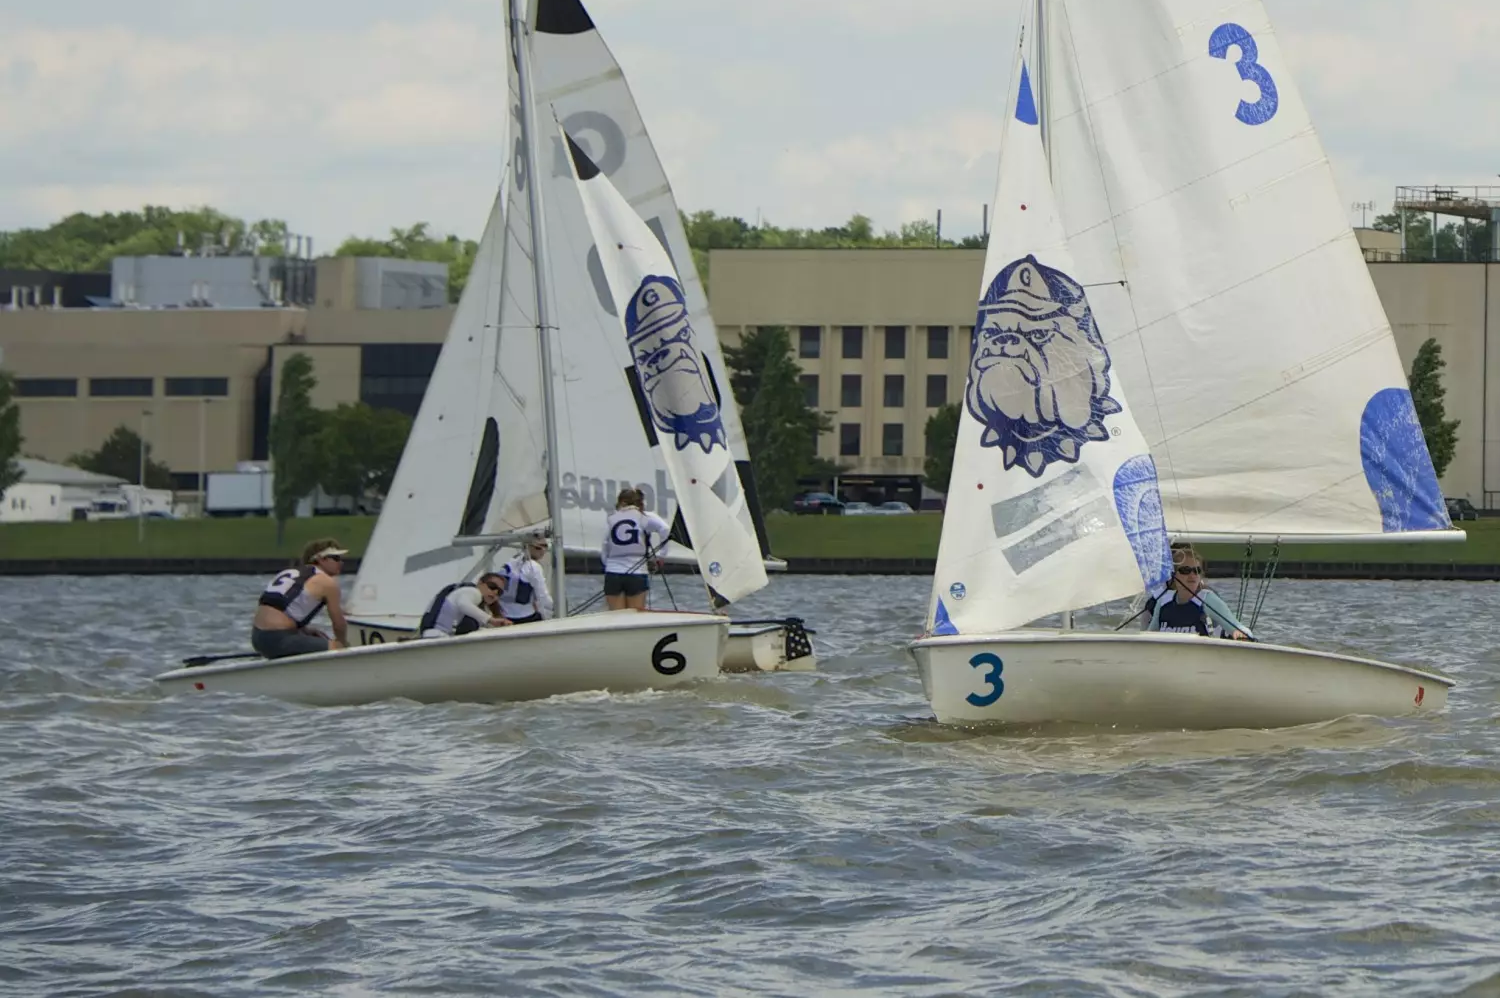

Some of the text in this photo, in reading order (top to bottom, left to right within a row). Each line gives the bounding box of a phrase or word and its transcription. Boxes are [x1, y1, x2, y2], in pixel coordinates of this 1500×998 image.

[1208, 22, 1278, 125] 3
[1020, 267, 1031, 288] G
[642, 288, 660, 307] G
[610, 518, 640, 546] G
[266, 568, 300, 595] G
[652, 632, 687, 675] 6
[965, 652, 1005, 707] 3
